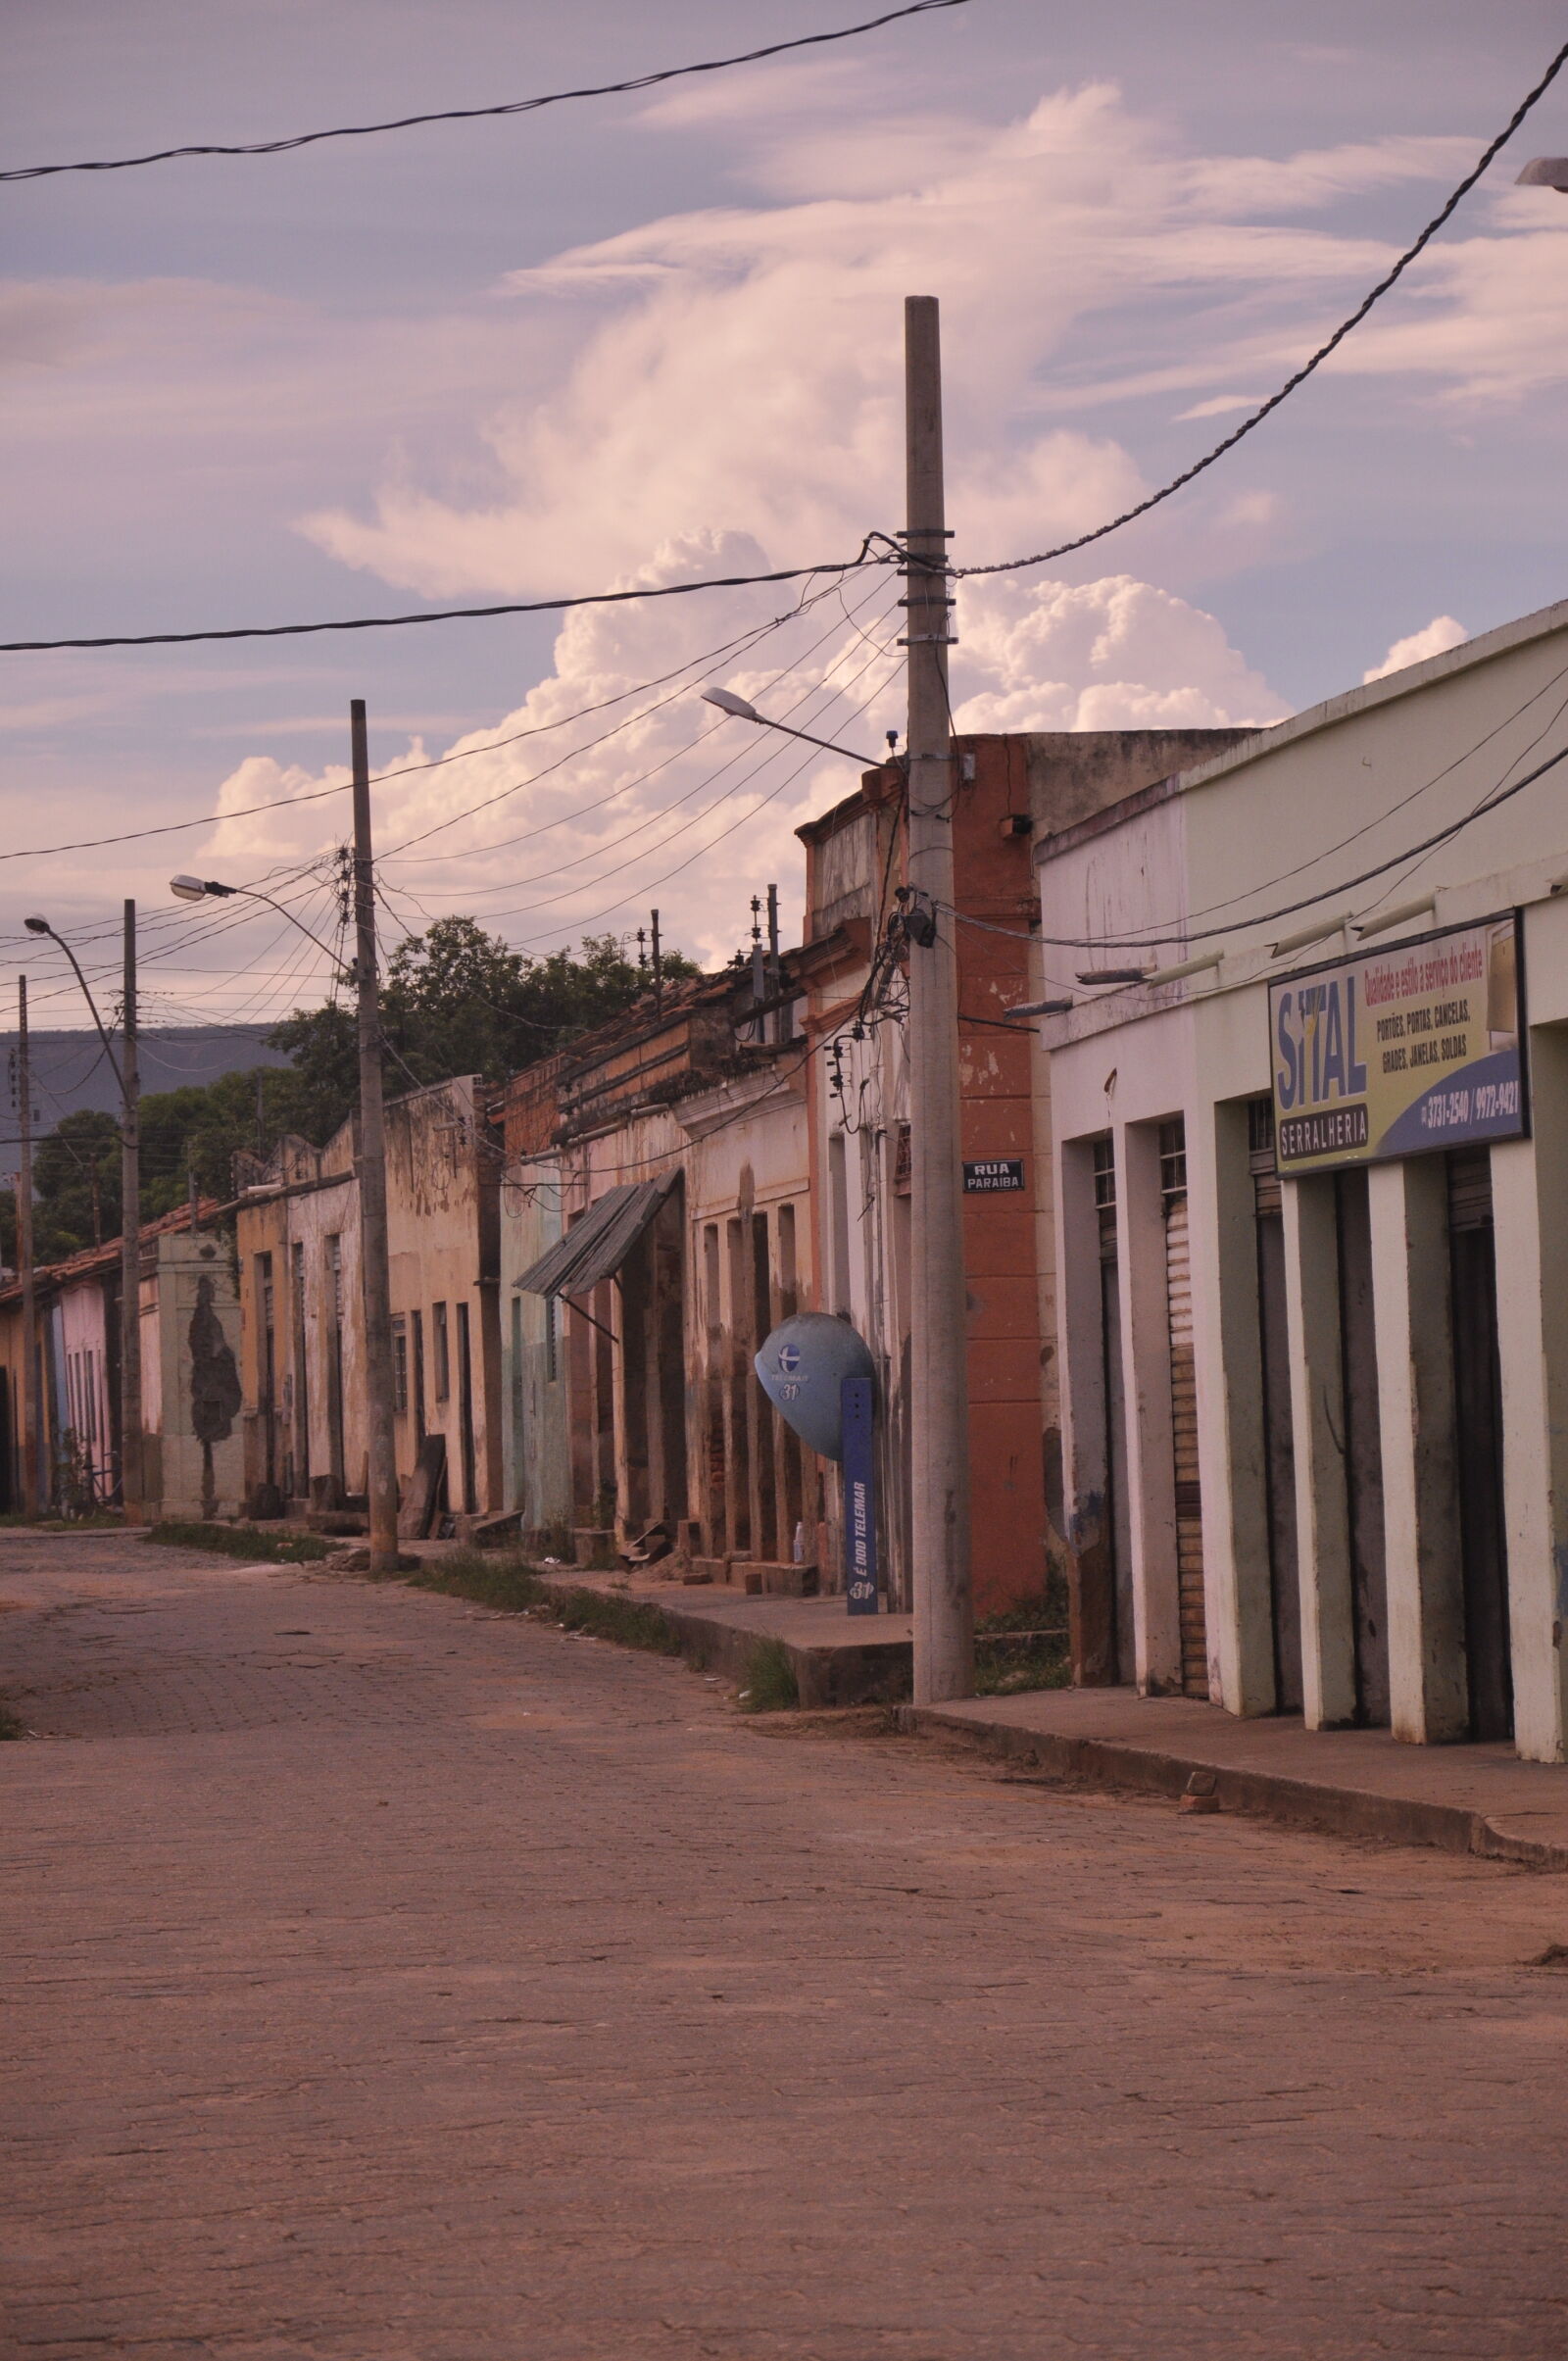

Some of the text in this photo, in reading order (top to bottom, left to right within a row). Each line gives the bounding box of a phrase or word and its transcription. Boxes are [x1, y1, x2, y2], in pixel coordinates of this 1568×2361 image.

[1365, 963, 1394, 1007] Qualidade
[1396, 971, 1399, 999] e
[1401, 957, 1418, 997] estilo
[1425, 948, 1448, 998] serviço
[1459, 941, 1483, 982] cliente
[1442, 1033, 1467, 1061] SOLDAS
[1428, 1090, 1469, 1129] 3731-2540
[1476, 1080, 1519, 1120] 9972-9421
[1282, 1111, 1366, 1155] SERRALHERIA
[974, 1163, 1009, 1175] RUA
[784, 1384, 797, 1401] 31
[854, 1482, 867, 1577] É DDD TELEMAR
[853, 1581, 871, 1599] 31
